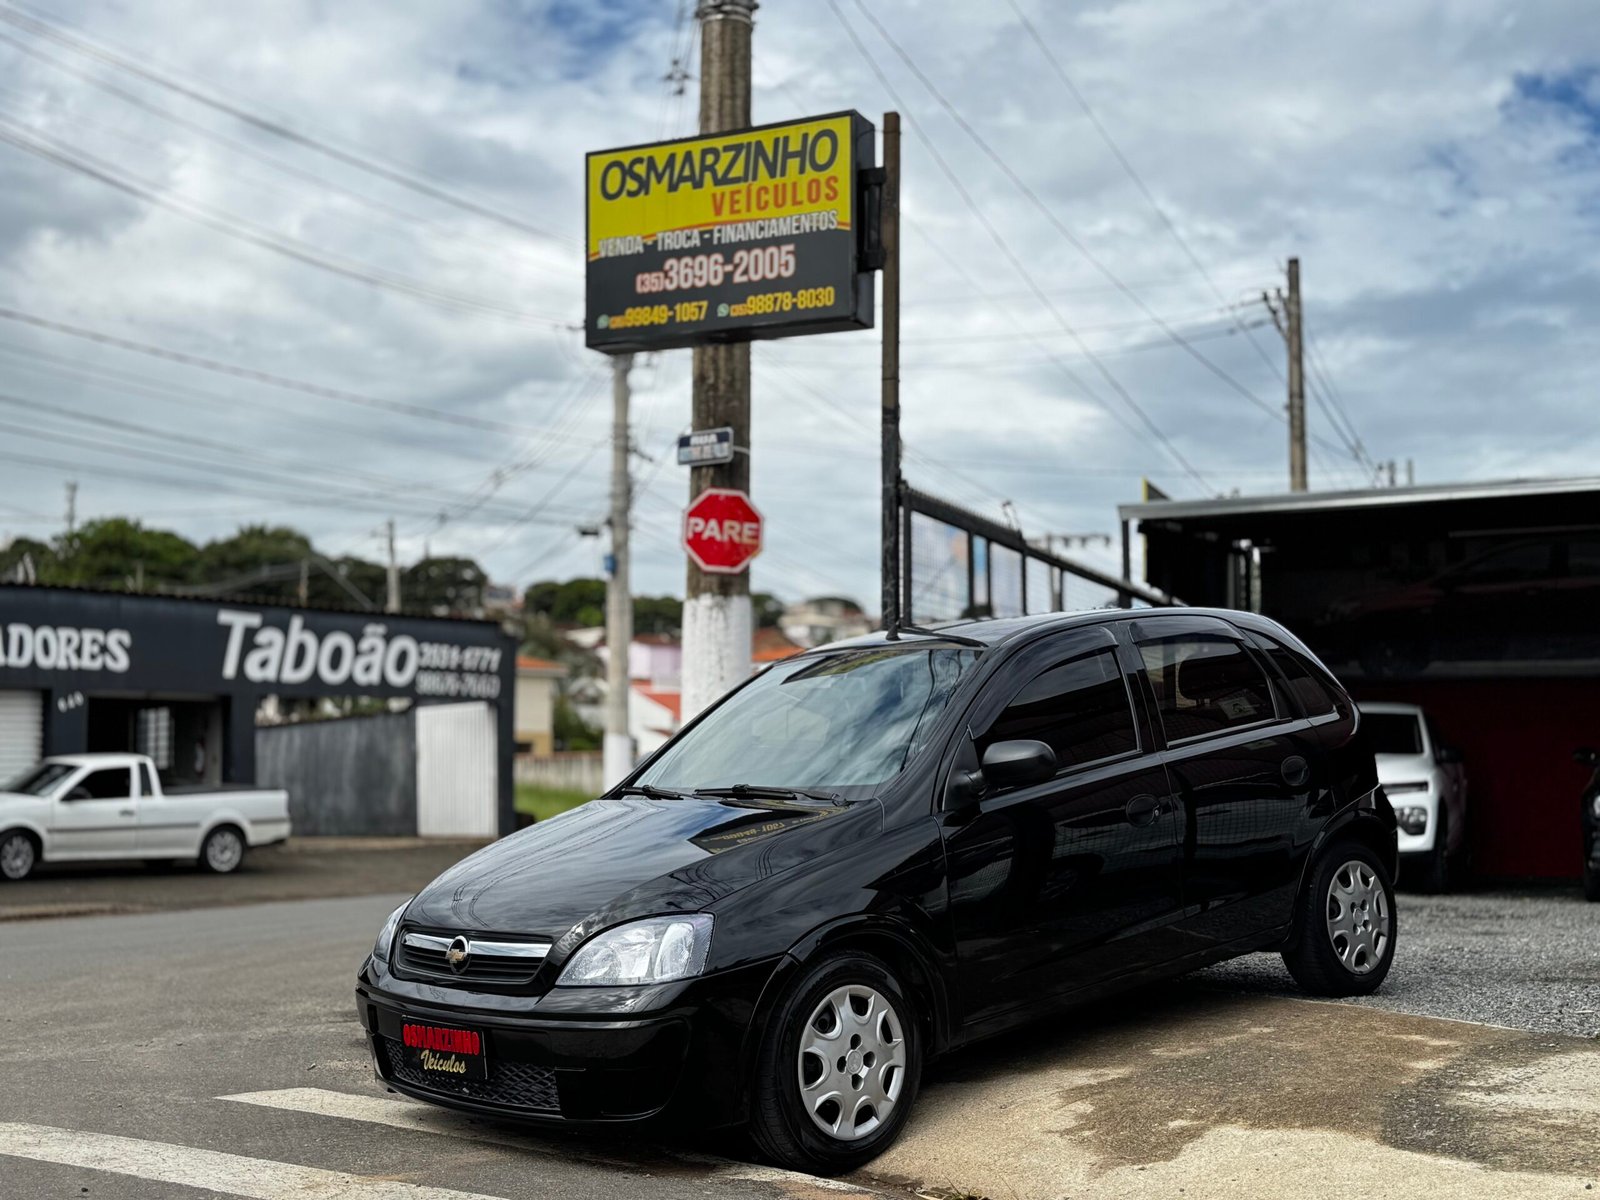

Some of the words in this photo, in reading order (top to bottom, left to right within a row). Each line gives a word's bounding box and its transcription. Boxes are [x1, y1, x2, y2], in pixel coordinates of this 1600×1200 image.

[601, 129, 839, 201] OSMARZINHO
[712, 175, 839, 217] VEÍCULOS
[598, 236, 644, 258] VENDA
[656, 228, 700, 252] TROCA
[713, 210, 838, 245] FINANCIAMENTOS
[636, 244, 796, 293] (35)3696-2005
[687, 516, 759, 545] PARE
[0, 622, 132, 673] DORES
[217, 609, 420, 687] Taboão
